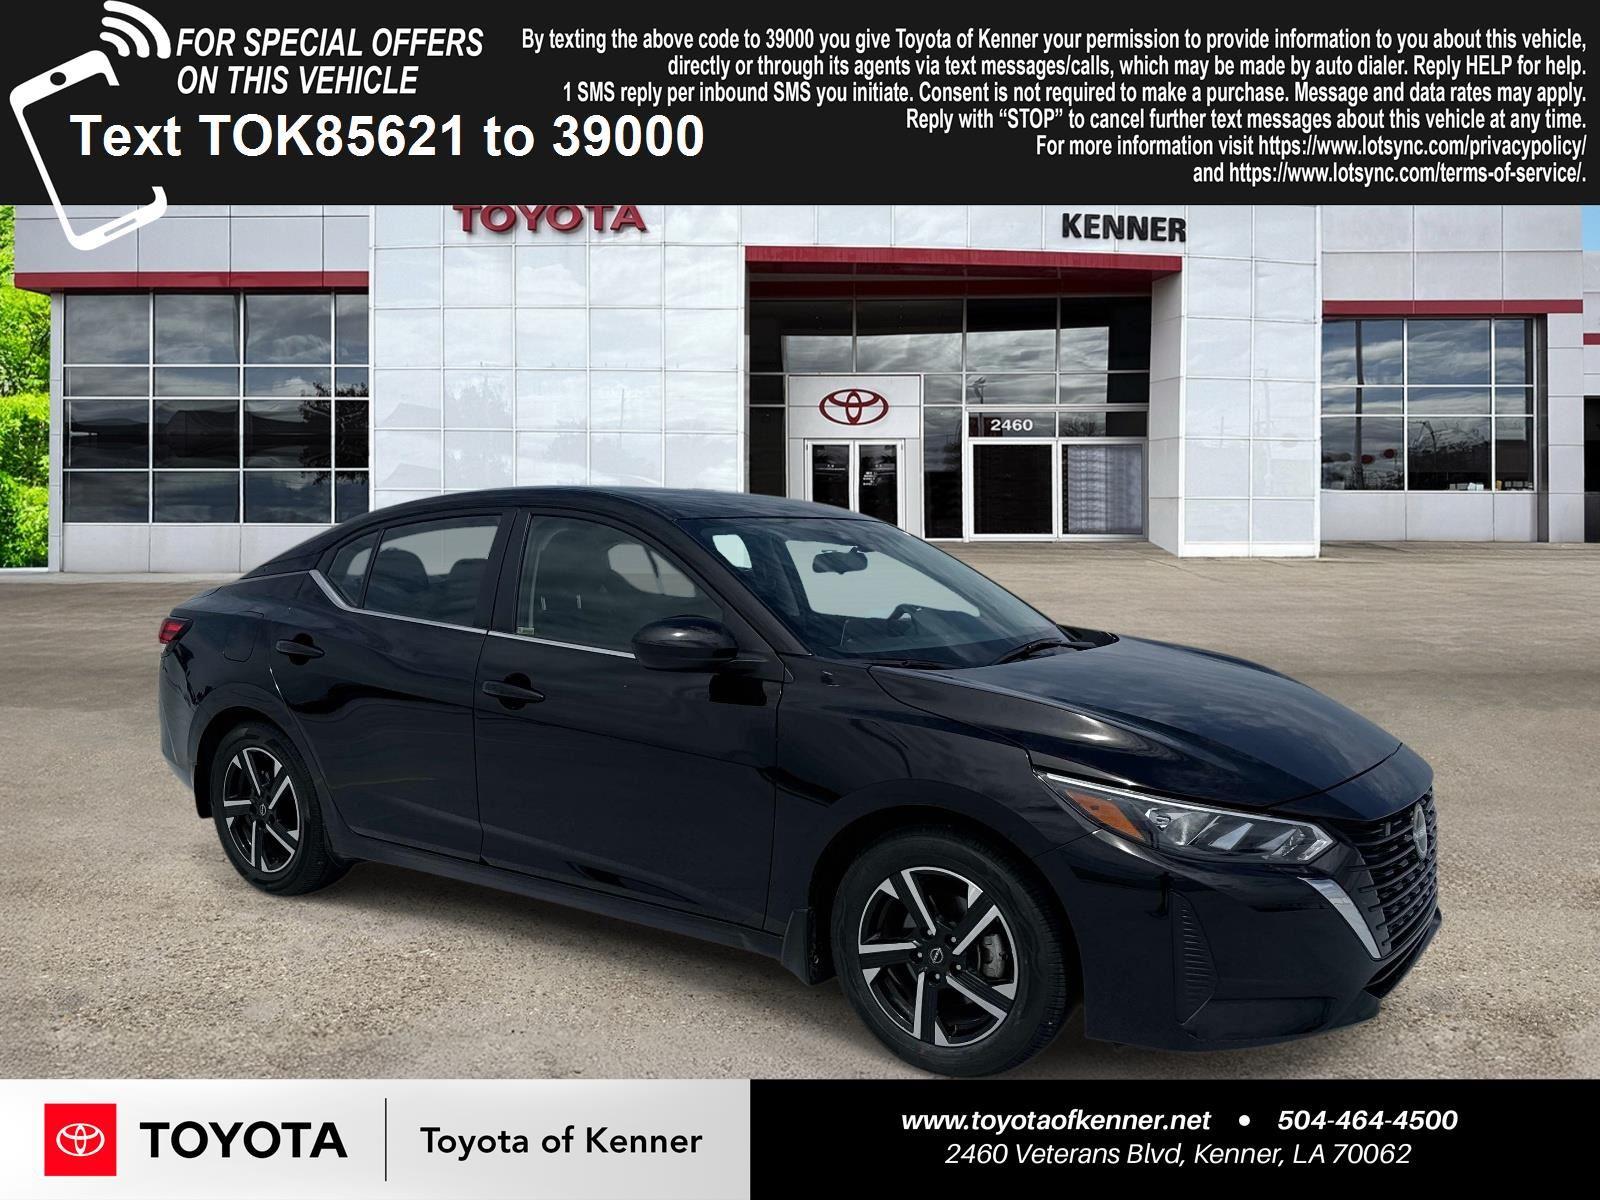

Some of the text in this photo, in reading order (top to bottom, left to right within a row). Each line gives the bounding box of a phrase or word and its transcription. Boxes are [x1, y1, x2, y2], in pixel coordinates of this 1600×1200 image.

[453, 205, 646, 232] TOYOTA
[1062, 213, 1187, 242] KENNER
[990, 419, 1033, 431] 2460
